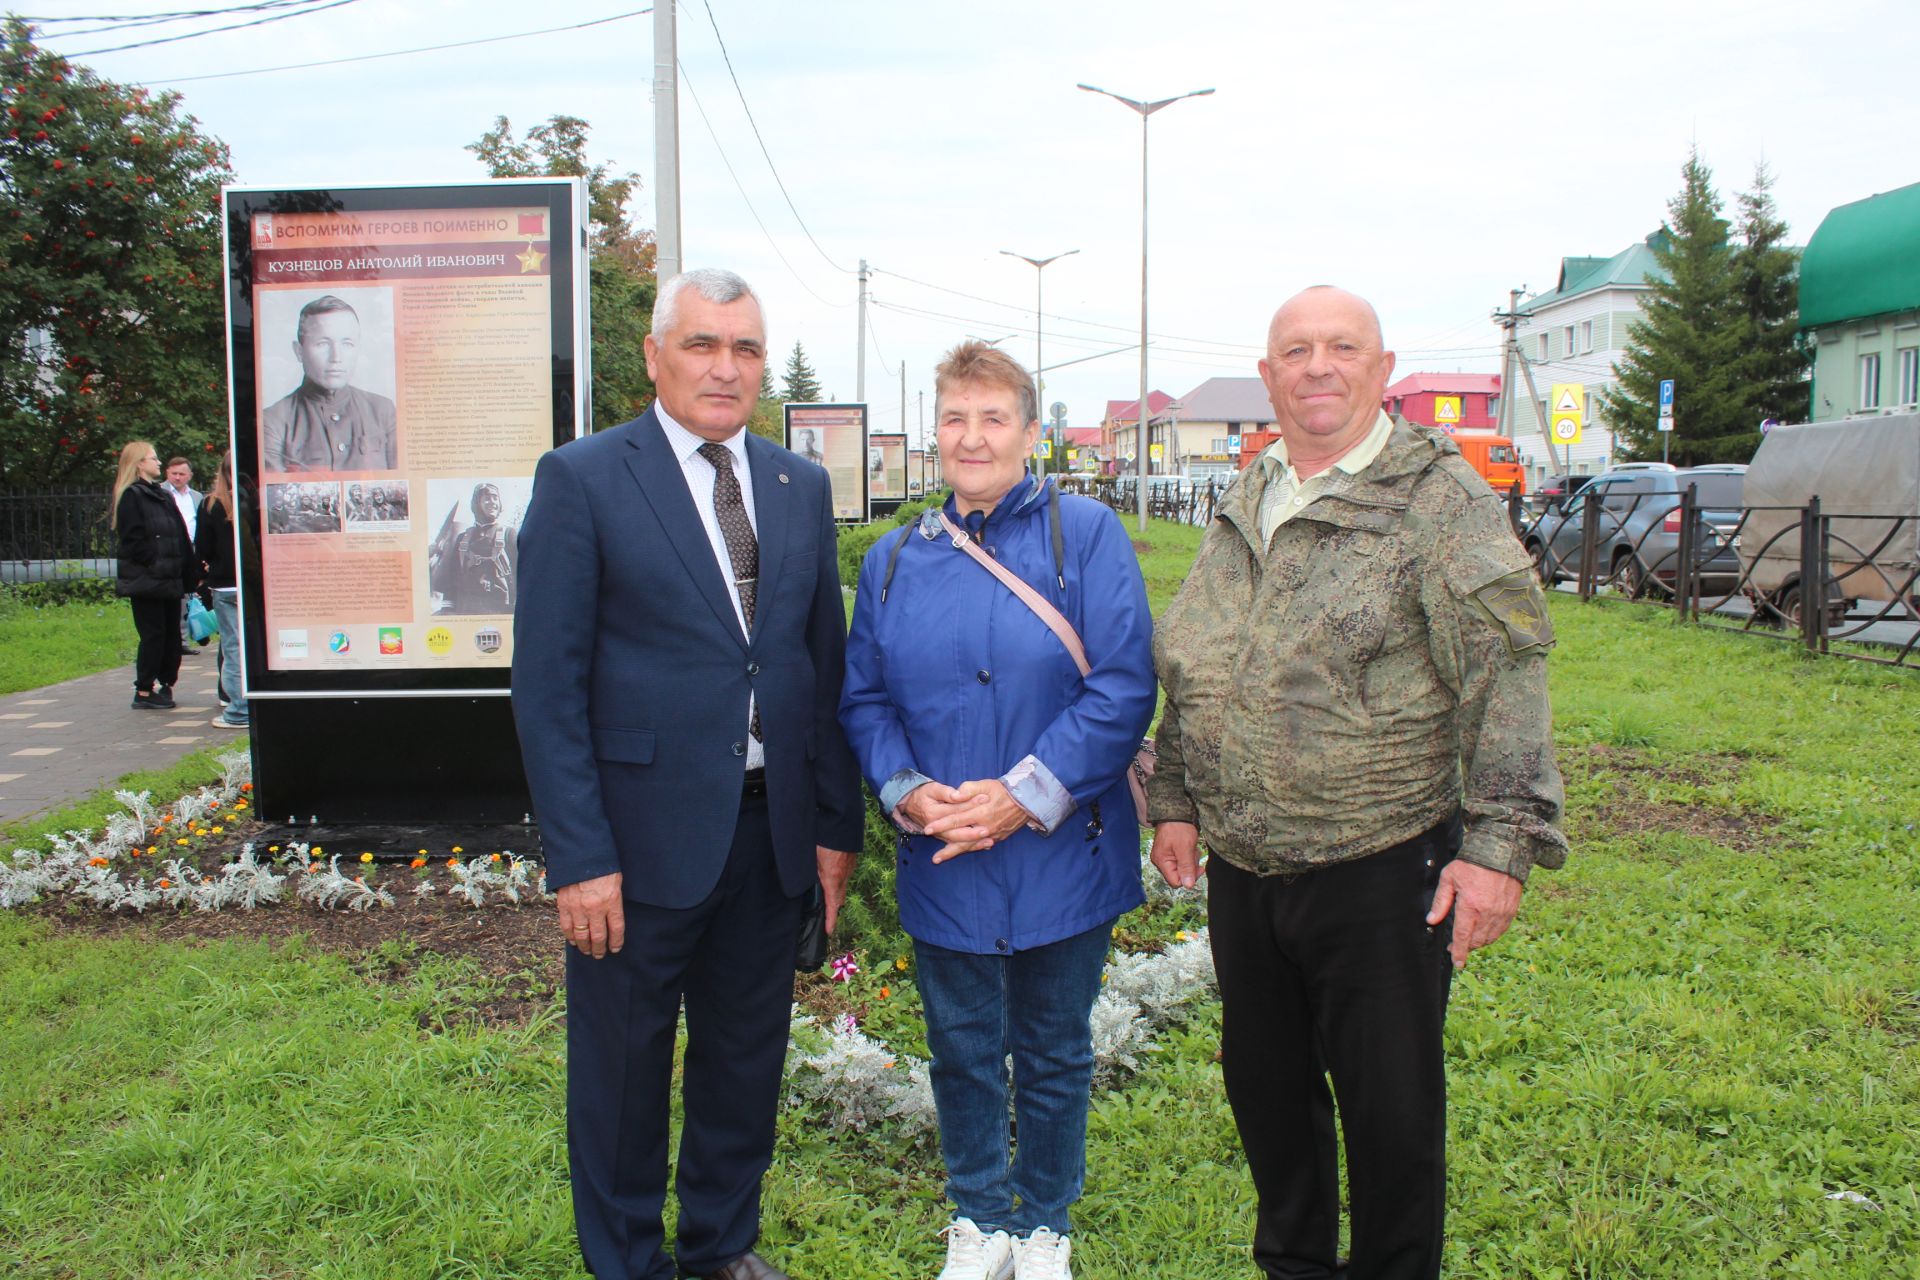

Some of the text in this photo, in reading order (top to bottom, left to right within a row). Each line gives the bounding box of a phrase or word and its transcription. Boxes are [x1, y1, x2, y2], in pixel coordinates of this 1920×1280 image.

[276, 218, 509, 239] ВСПОМНИМ ГЕРОЕВ ПОИМЕННО
[268, 254, 505, 273] КУЗНЕЦОВ АНАТОЛИЙ ИВАНОВИЧ
[1663, 383, 1672, 403] P
[1560, 424, 1573, 434] 20
[1231, 436, 1239, 446] P
